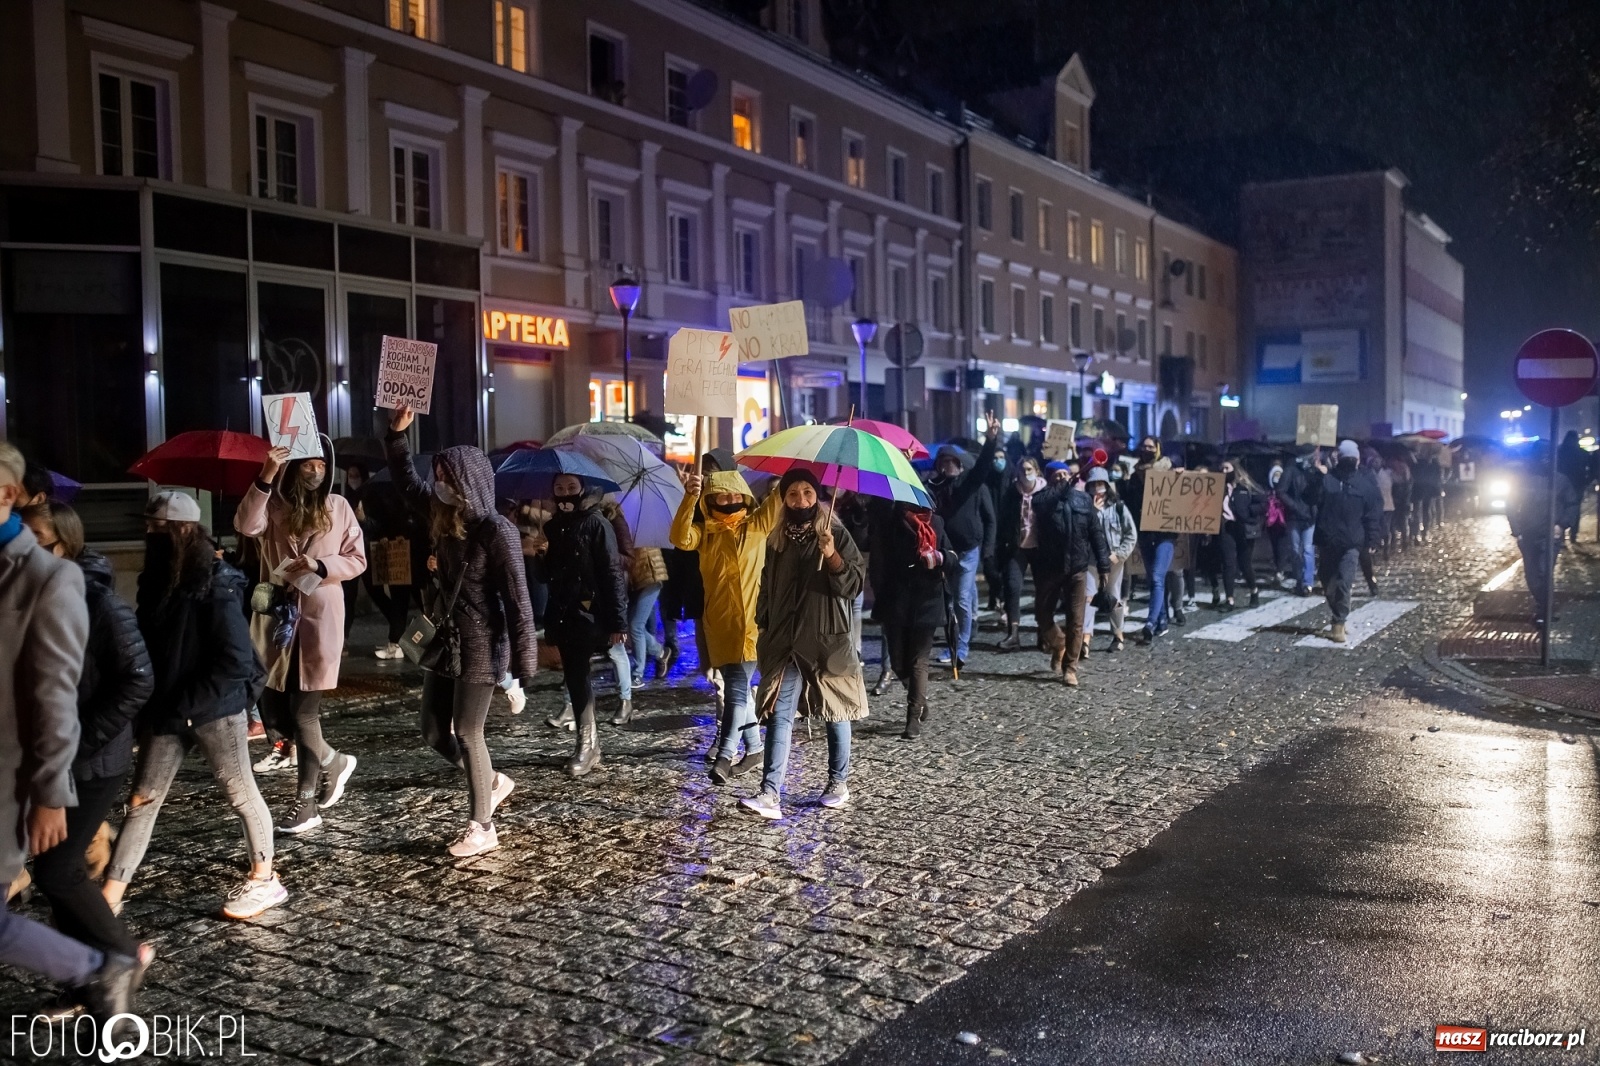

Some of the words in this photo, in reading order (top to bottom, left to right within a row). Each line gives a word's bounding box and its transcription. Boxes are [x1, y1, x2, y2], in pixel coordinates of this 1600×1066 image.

[731, 309, 751, 332] NO
[685, 331, 716, 354] PIS
[738, 336, 761, 362] NO
[386, 350, 419, 364] KOCHAM
[385, 360, 430, 376] ROZUMIEM
[672, 358, 703, 377] GRA
[383, 381, 427, 399] ODDAĆ
[672, 380, 694, 399] NA
[382, 394, 396, 405] NIE
[401, 398, 428, 410] UMIEM
[1147, 498, 1171, 516] NIE
[1159, 514, 1216, 532] ZAKAZ
